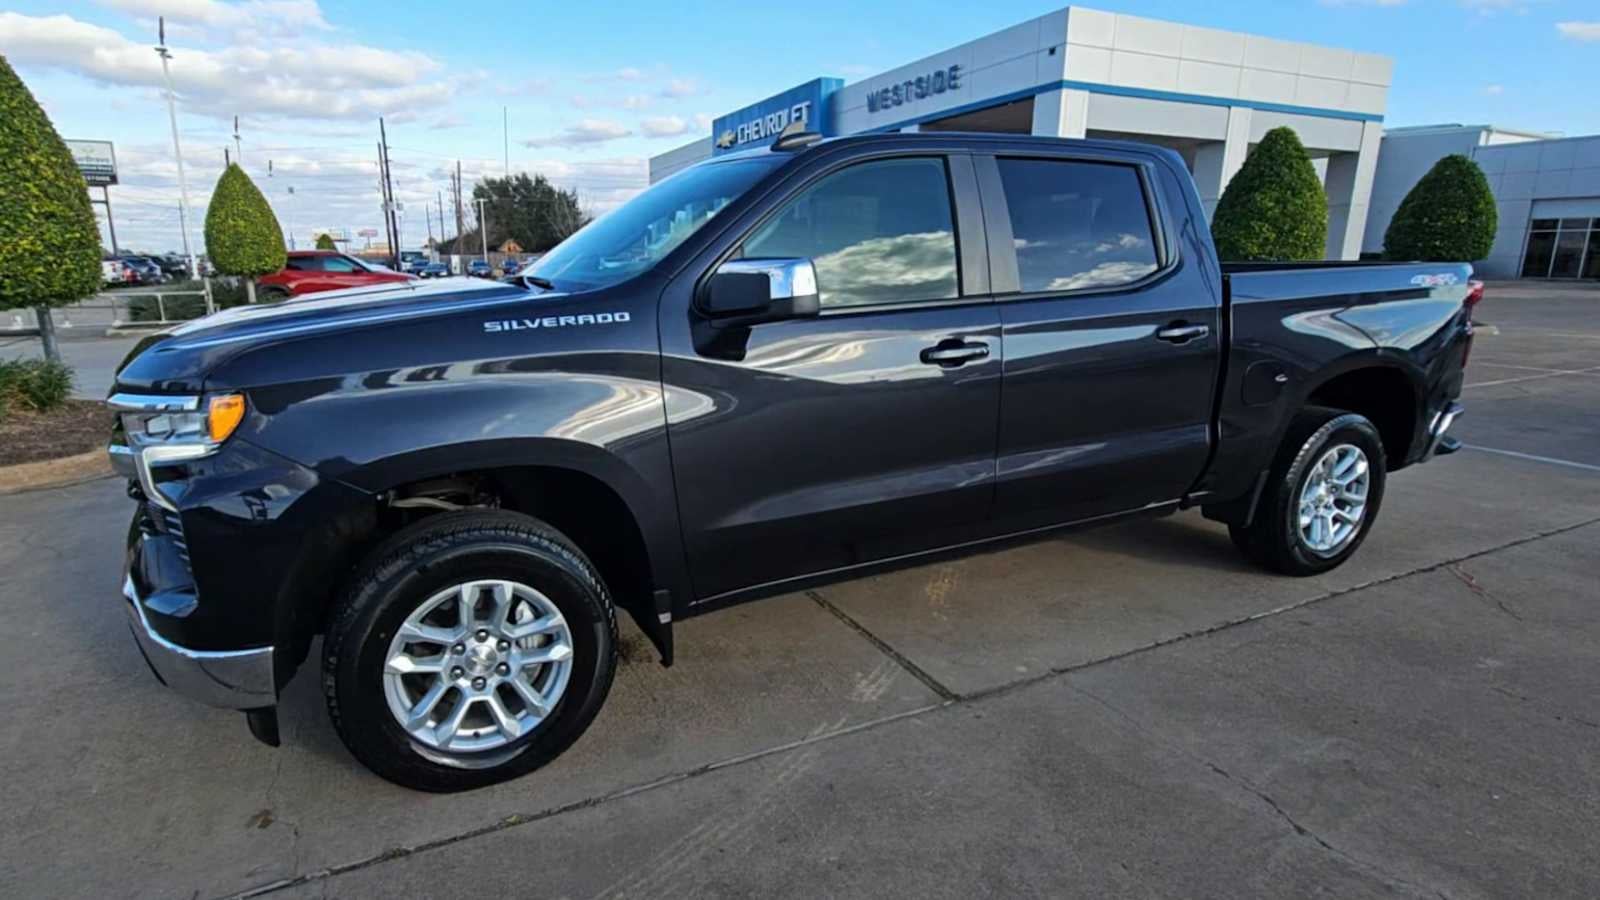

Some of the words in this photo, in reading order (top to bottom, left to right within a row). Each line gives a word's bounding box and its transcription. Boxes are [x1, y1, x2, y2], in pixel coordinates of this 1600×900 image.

[866, 64, 962, 113] WESTSIDE
[737, 100, 811, 144] CHEVROLET
[483, 311, 631, 333] SILVERADO
